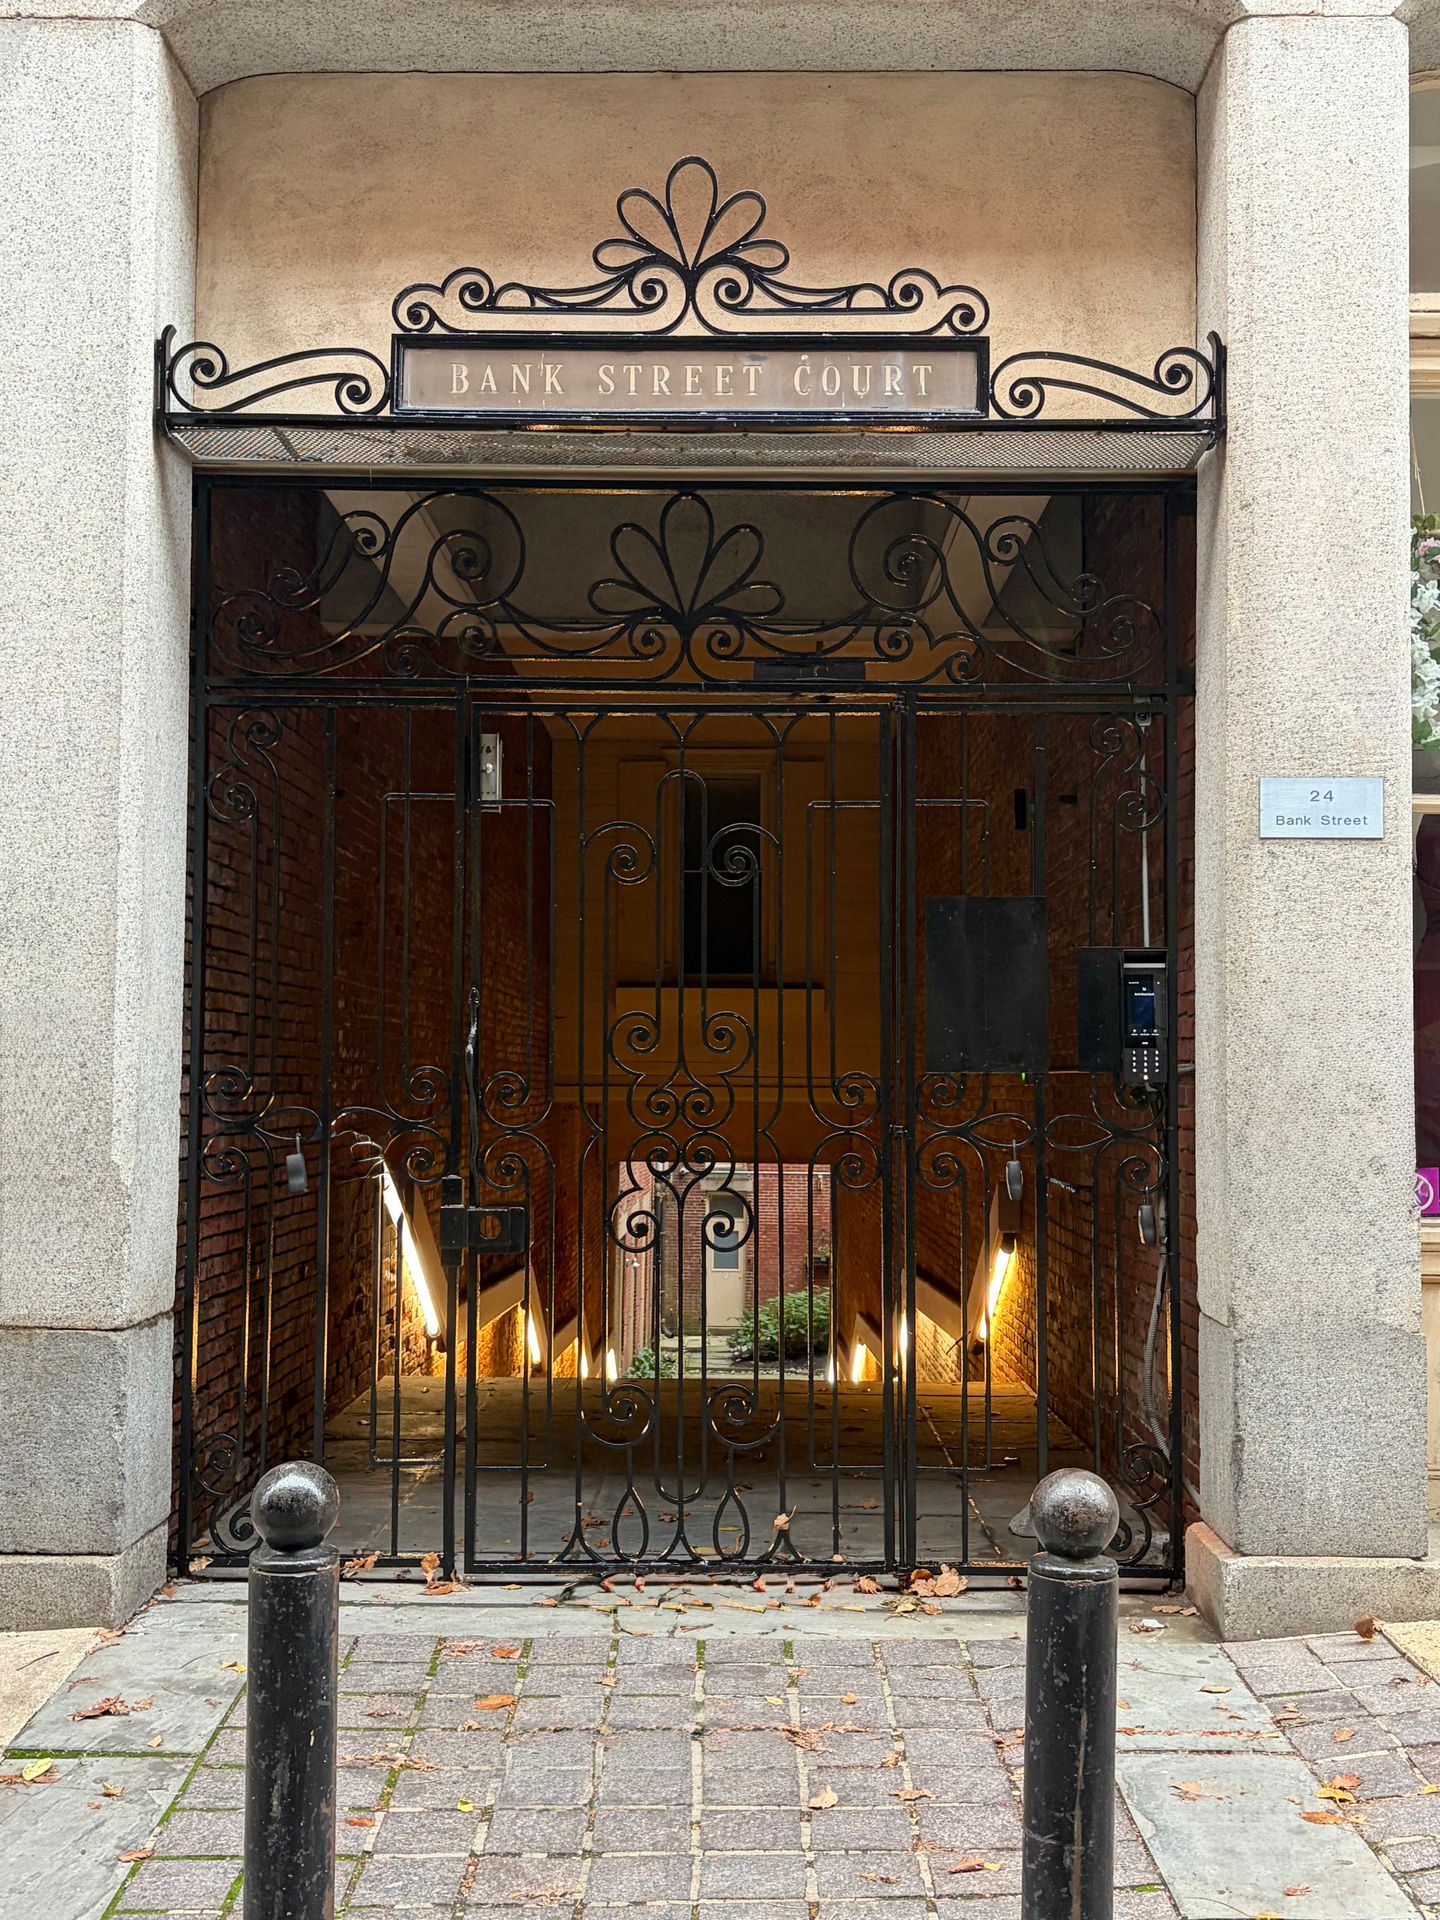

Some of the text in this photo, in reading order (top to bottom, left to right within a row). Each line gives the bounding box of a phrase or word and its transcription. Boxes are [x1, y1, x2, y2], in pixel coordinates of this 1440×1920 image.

[449, 364, 933, 396] BANK STREET COURT
[1309, 790, 1334, 802] 24
[1275, 815, 1368, 826] Bank Street
